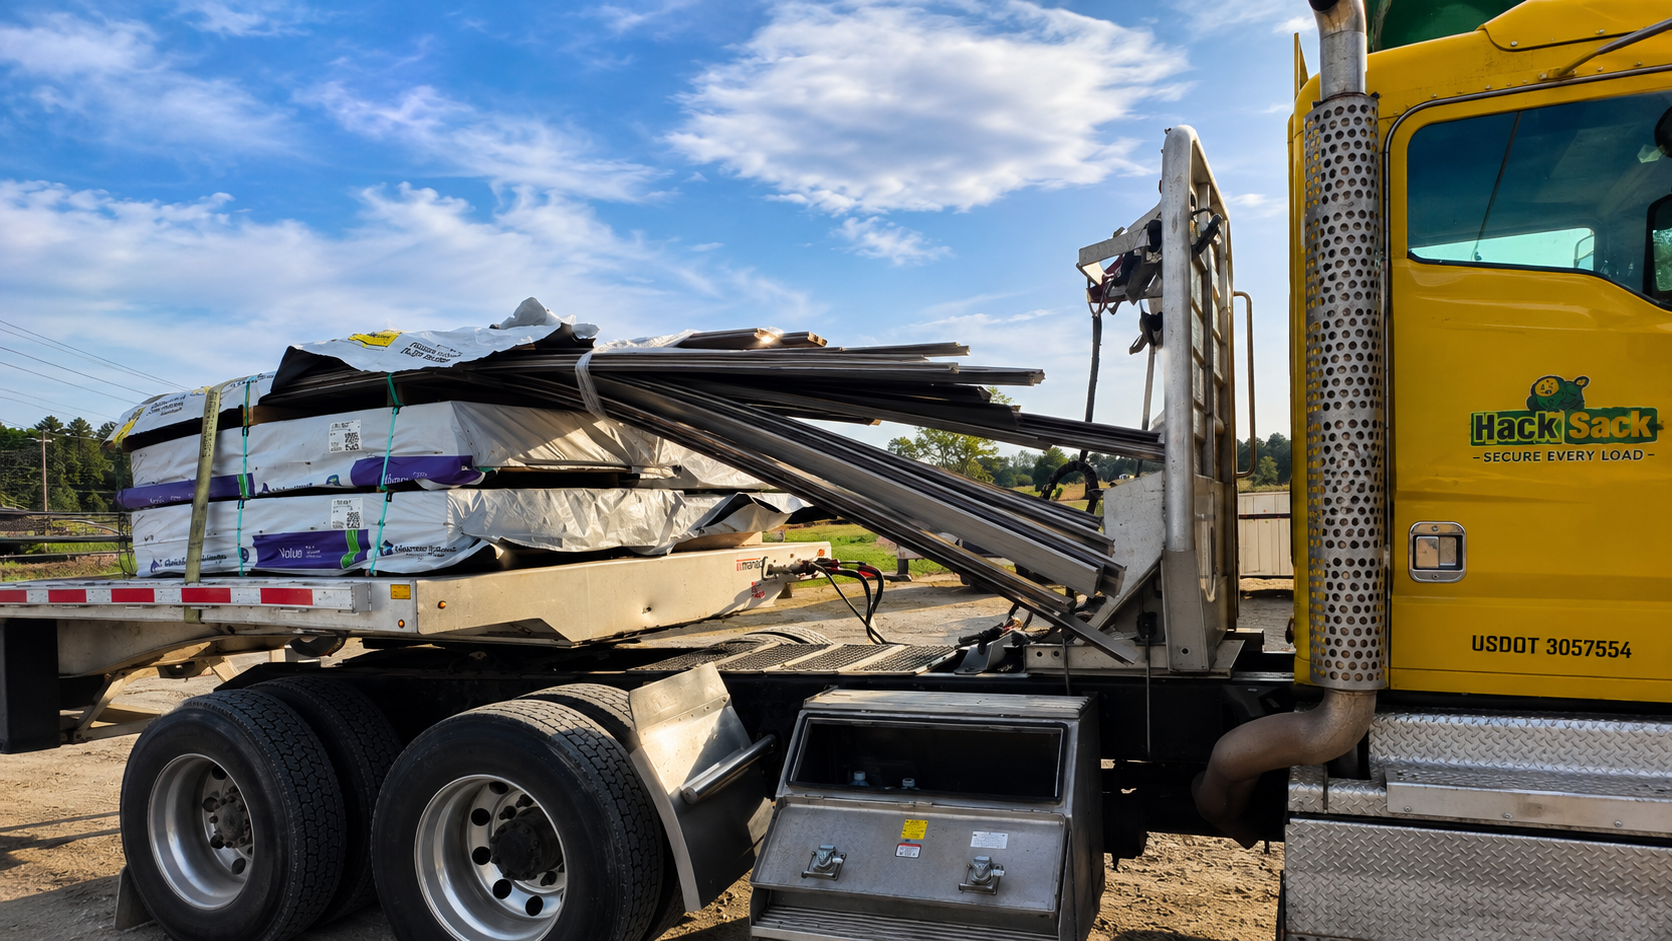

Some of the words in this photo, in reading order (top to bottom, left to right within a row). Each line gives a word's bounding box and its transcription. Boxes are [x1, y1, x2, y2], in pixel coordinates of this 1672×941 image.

[1475, 412, 1559, 441] Hack
[1569, 410, 1653, 439] Sack
[1483, 451, 1541, 463] SECURE
[1547, 450, 1595, 462] EVERY
[1601, 449, 1644, 461] LOAD
[1472, 635, 1540, 654] USDOT
[1546, 638, 1632, 658] 3057554
